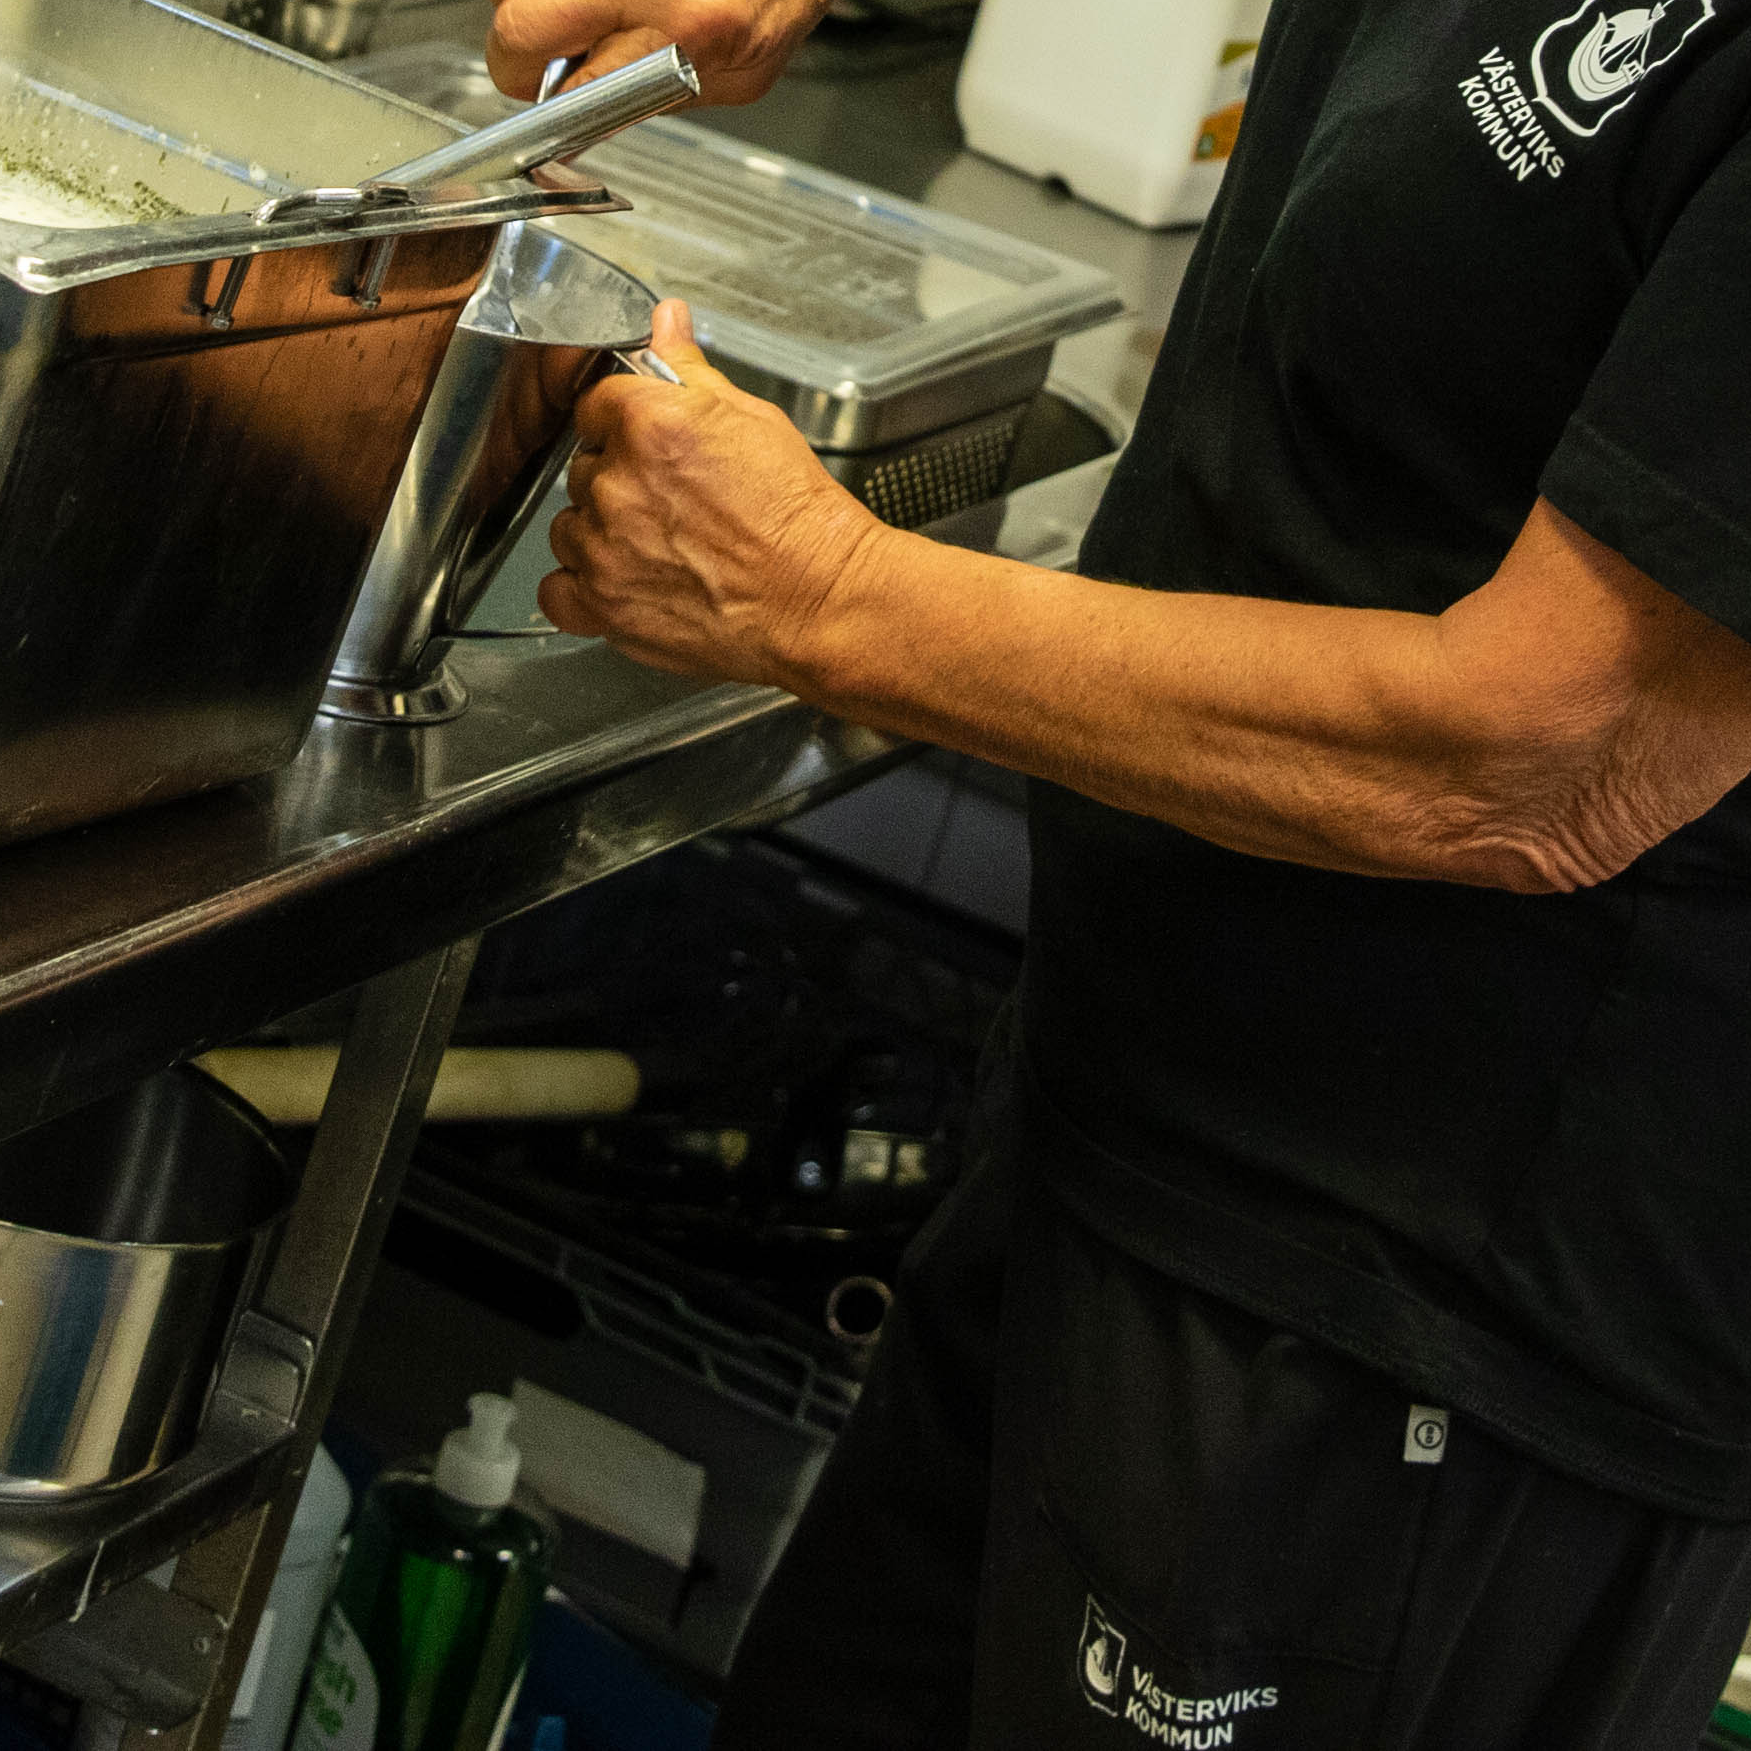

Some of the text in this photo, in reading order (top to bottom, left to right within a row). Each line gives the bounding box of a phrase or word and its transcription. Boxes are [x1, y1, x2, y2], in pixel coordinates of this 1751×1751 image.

[1458, 75, 1537, 182] KOMMUN
[1478, 46, 1565, 179] VÄSTERVIKS
[1125, 1696, 1233, 1750] KOMMUN
